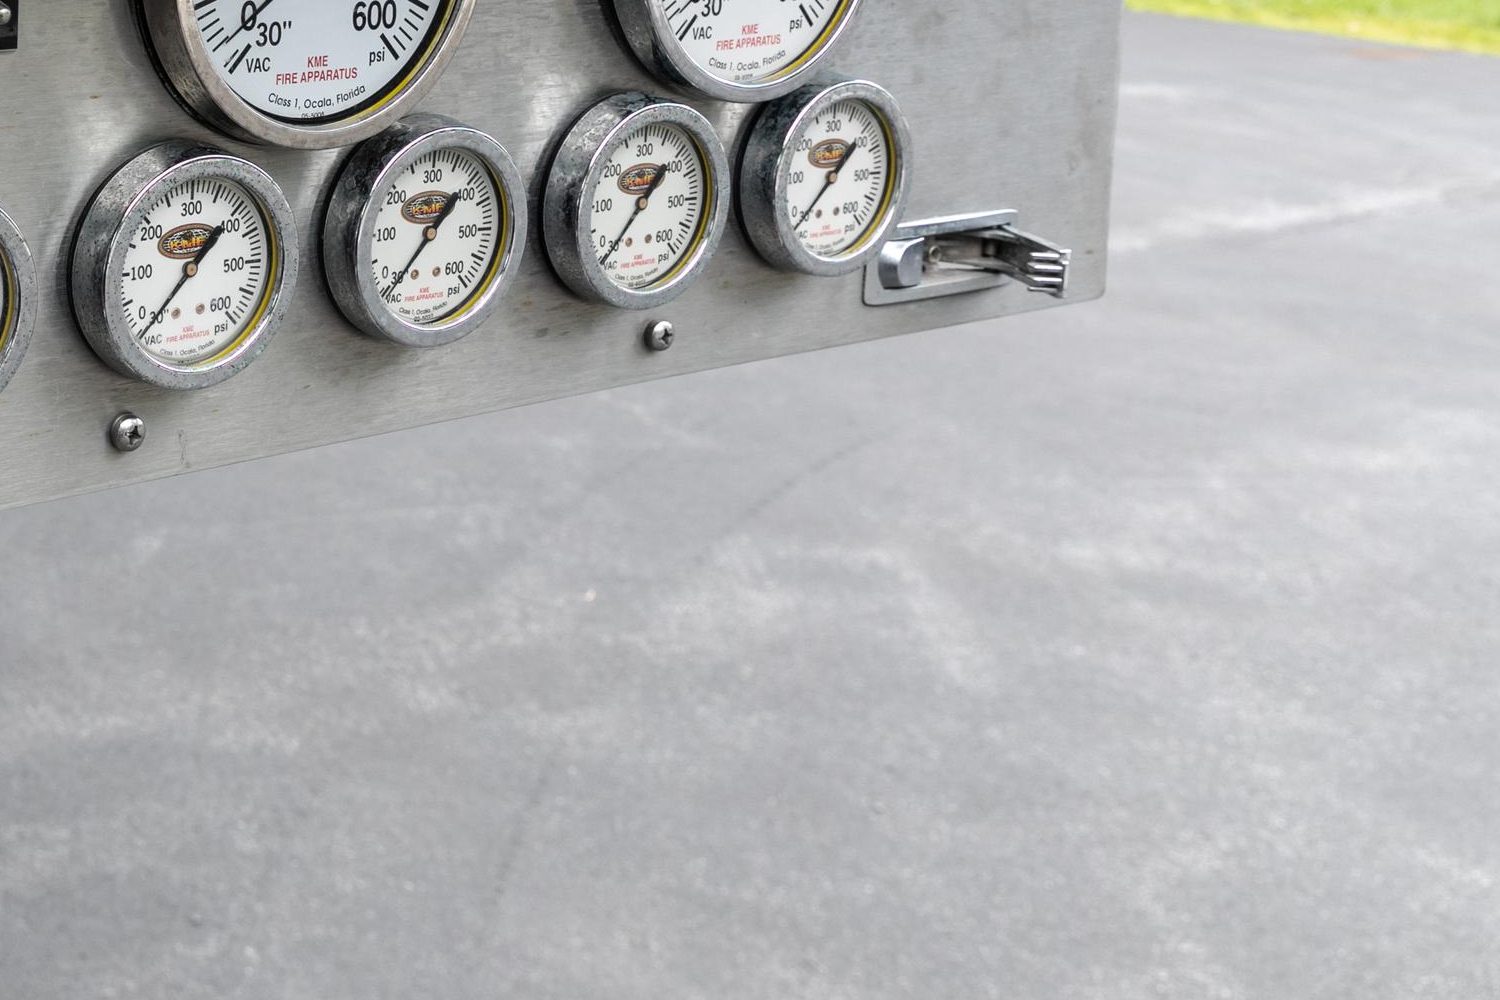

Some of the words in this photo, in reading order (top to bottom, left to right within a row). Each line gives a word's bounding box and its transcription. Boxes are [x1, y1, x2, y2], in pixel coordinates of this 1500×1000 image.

[240, 0, 257, 32] 0
[352, 0, 396, 32] 600
[741, 23, 758, 36] KME
[789, 16, 804, 33] psi
[256, 20, 293, 48] 30"
[692, 25, 713, 41] VAC
[716, 38, 734, 52] FIRE
[735, 34, 781, 49] APPARATUS
[307, 55, 328, 68] KME
[369, 47, 386, 66] psi
[708, 57, 727, 70] Class
[762, 49, 787, 66] Florida
[246, 56, 271, 74] VAC
[275, 71, 298, 86] FIRE
[300, 67, 358, 84] APPARATUS
[268, 92, 291, 108] Class
[303, 97, 335, 109] Ocala,
[336, 84, 366, 104] Florida
[825, 119, 842, 133] 300
[636, 143, 653, 158] 300
[796, 138, 812, 152] 200
[604, 163, 621, 179] 200
[665, 159, 682, 174] 400
[423, 169, 442, 184] 300
[788, 171, 804, 185] 100
[854, 168, 870, 182] 500
[387, 190, 406, 206] 200
[457, 187, 475, 202] 400
[667, 194, 684, 209] 500
[180, 200, 203, 217] 300
[595, 198, 612, 213] 100
[791, 205, 798, 218] 0
[842, 200, 858, 215] 600
[140, 224, 162, 241] 200
[376, 226, 396, 242] 100
[458, 224, 477, 239] 500
[655, 228, 672, 244] 600
[844, 222, 856, 235] psi
[599, 235, 606, 248] 0
[223, 256, 244, 273] 500
[657, 250, 669, 264] psi
[130, 264, 152, 281] 100
[381, 266, 388, 279] 0
[444, 260, 464, 276] 600
[603, 260, 617, 271] VAC
[447, 283, 460, 298] psi
[210, 295, 231, 313] 600
[386, 293, 401, 305] VAC
[138, 306, 146, 320] 0
[214, 320, 228, 336] psi
[144, 334, 162, 346] VAC
